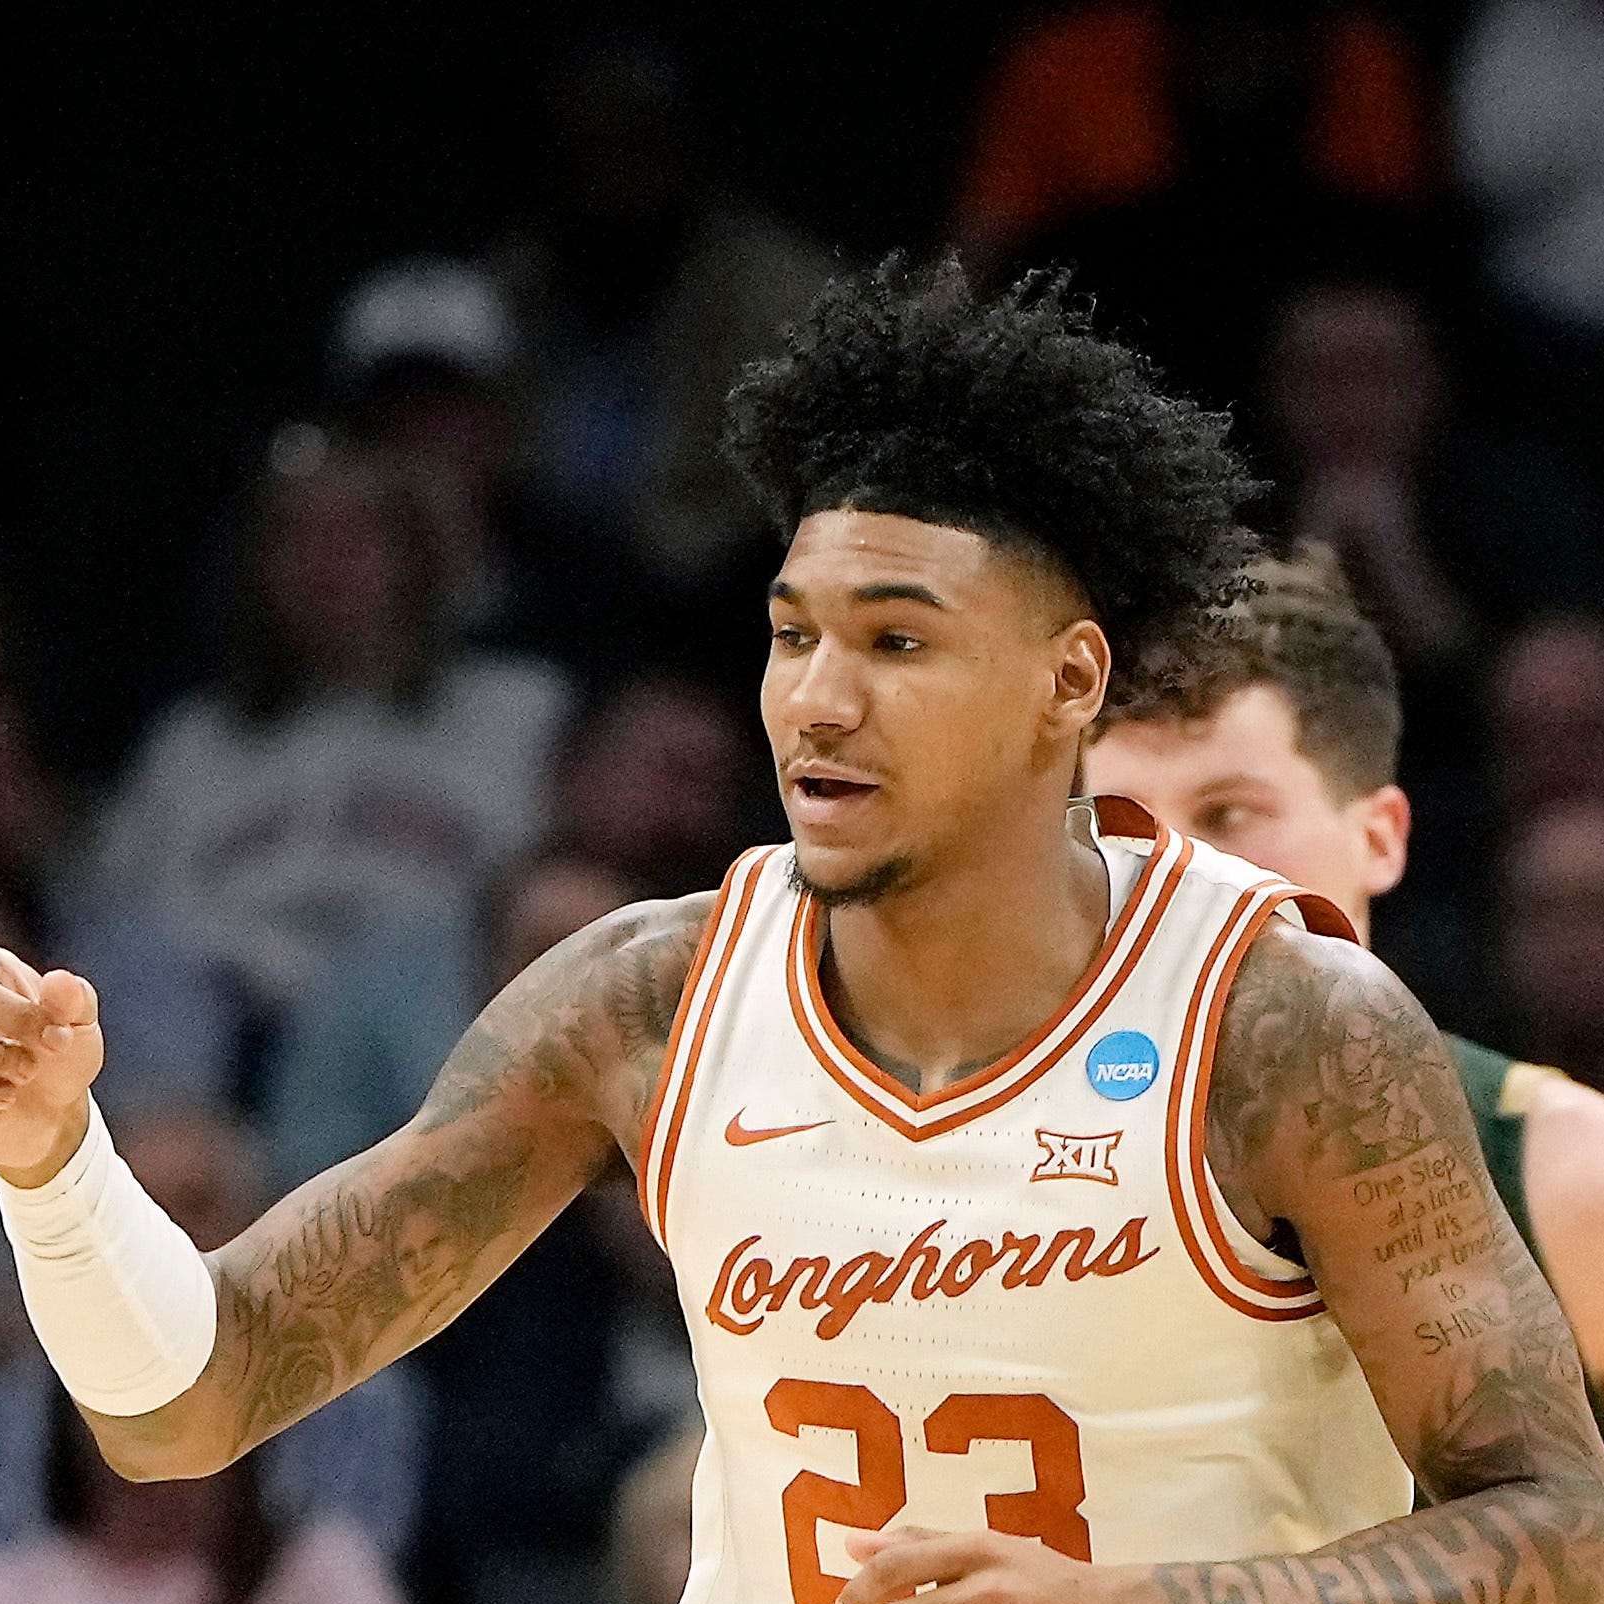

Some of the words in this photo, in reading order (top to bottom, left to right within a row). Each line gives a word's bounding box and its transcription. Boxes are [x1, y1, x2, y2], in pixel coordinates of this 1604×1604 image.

[1096, 1062, 1154, 1082] NCAA
[1030, 1128, 1123, 1186] XII
[1353, 1174, 1406, 1207] One
[1409, 1155, 1456, 1187] Step
[1388, 1201, 1406, 1228] at
[1413, 1203, 1427, 1219] a
[1429, 1179, 1472, 1210] time
[1374, 1223, 1424, 1263] until
[1434, 1212, 1462, 1240] it's
[706, 1217, 1160, 1340] Longhorns
[1396, 1253, 1445, 1294] your
[1440, 1283, 1466, 1303] to
